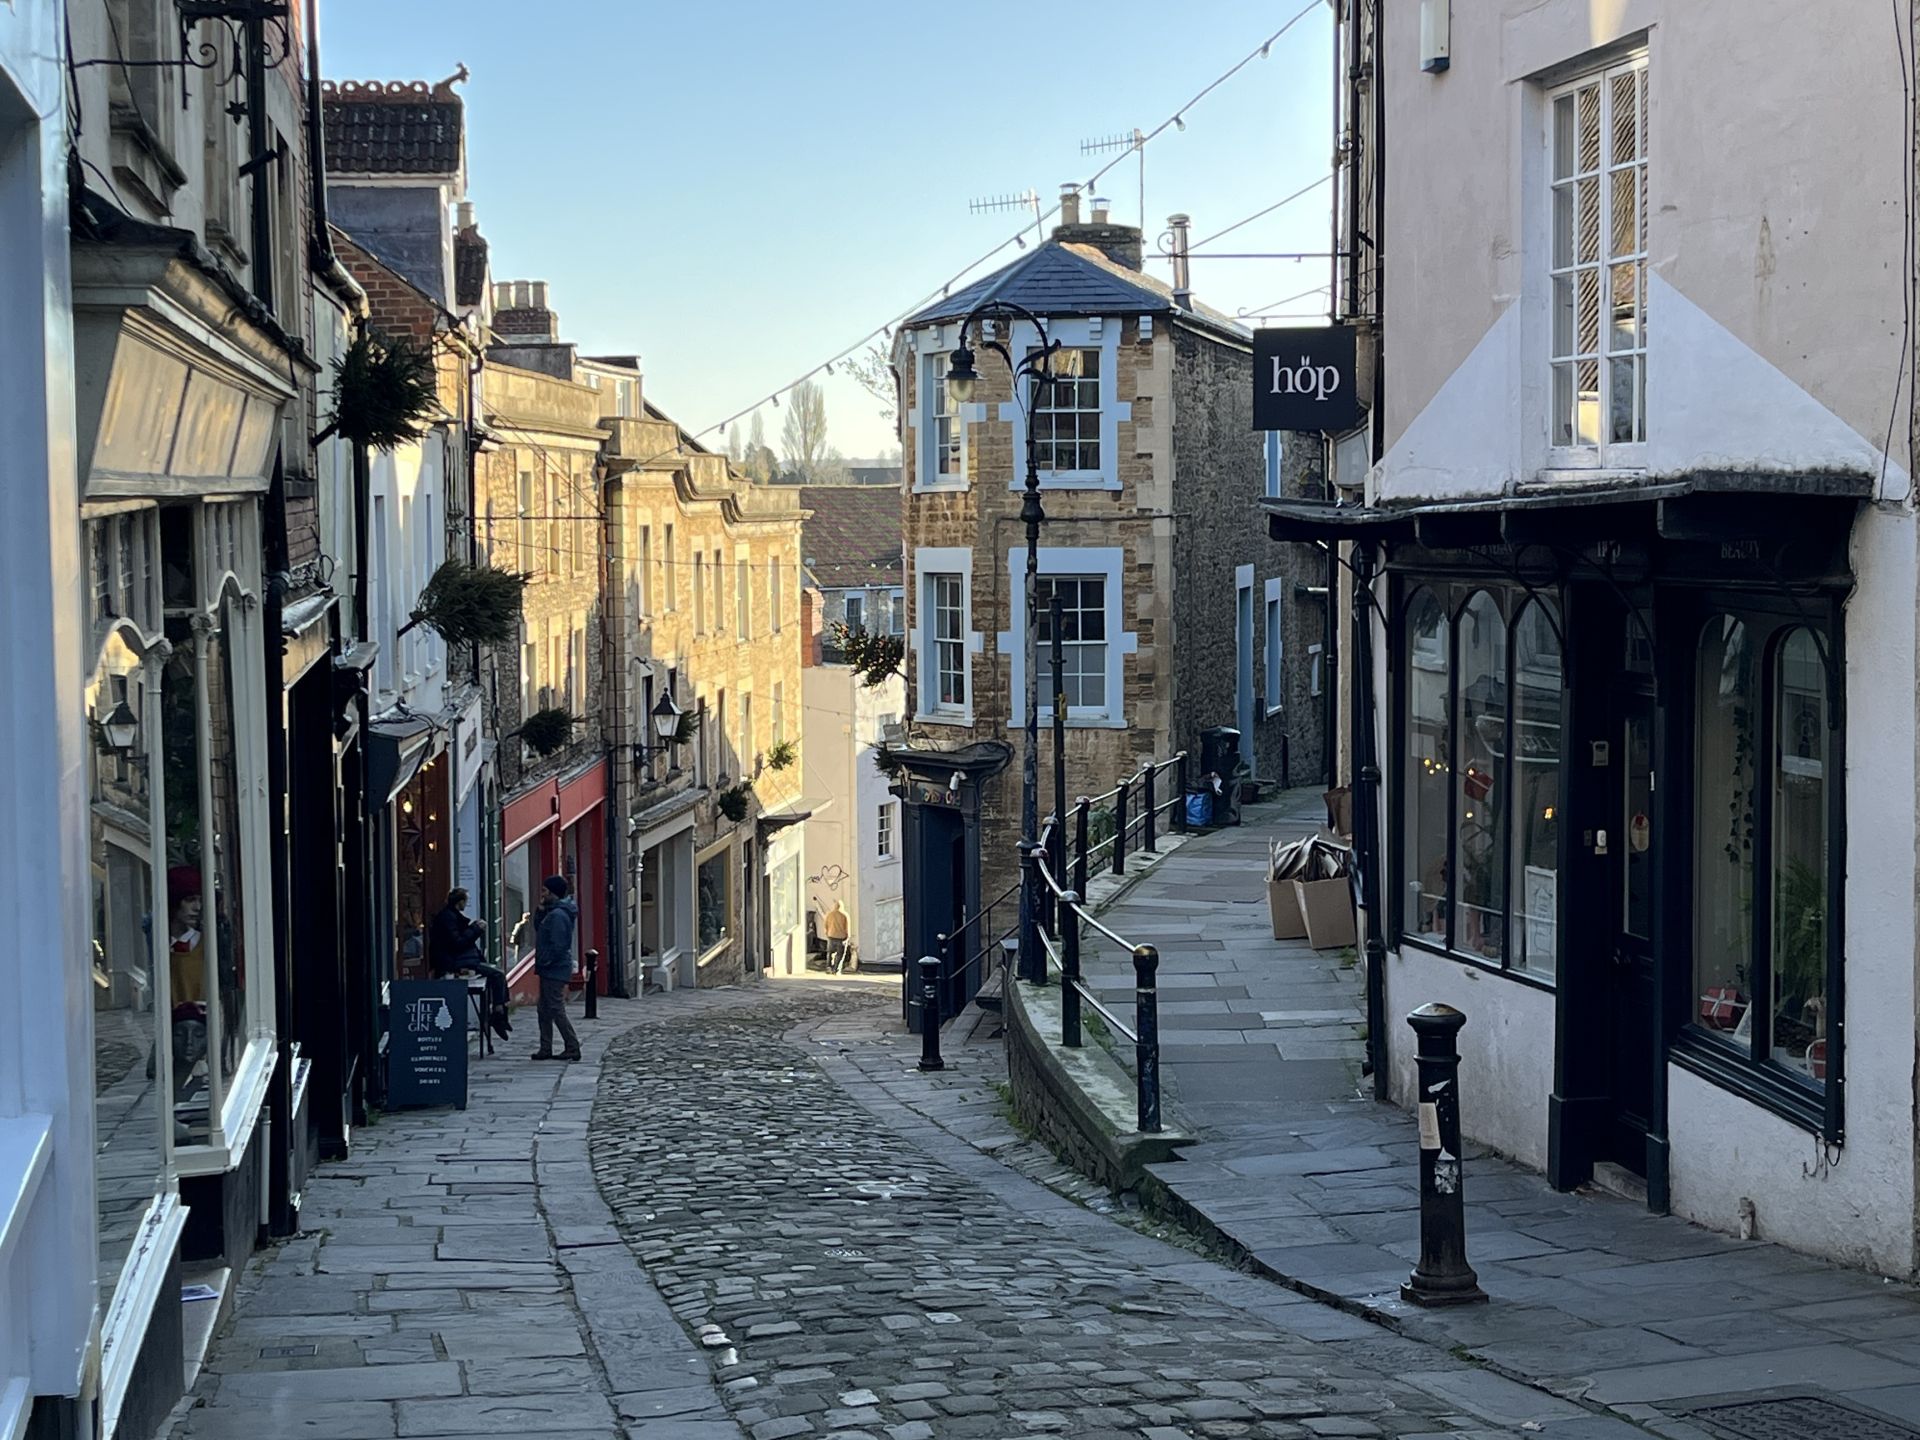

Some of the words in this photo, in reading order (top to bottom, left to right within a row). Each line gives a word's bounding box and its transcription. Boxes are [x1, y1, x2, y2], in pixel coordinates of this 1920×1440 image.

[405, 1003, 434, 1013] STILL
[411, 1013, 434, 1022] LIFE
[408, 1022, 430, 1032] GIN
